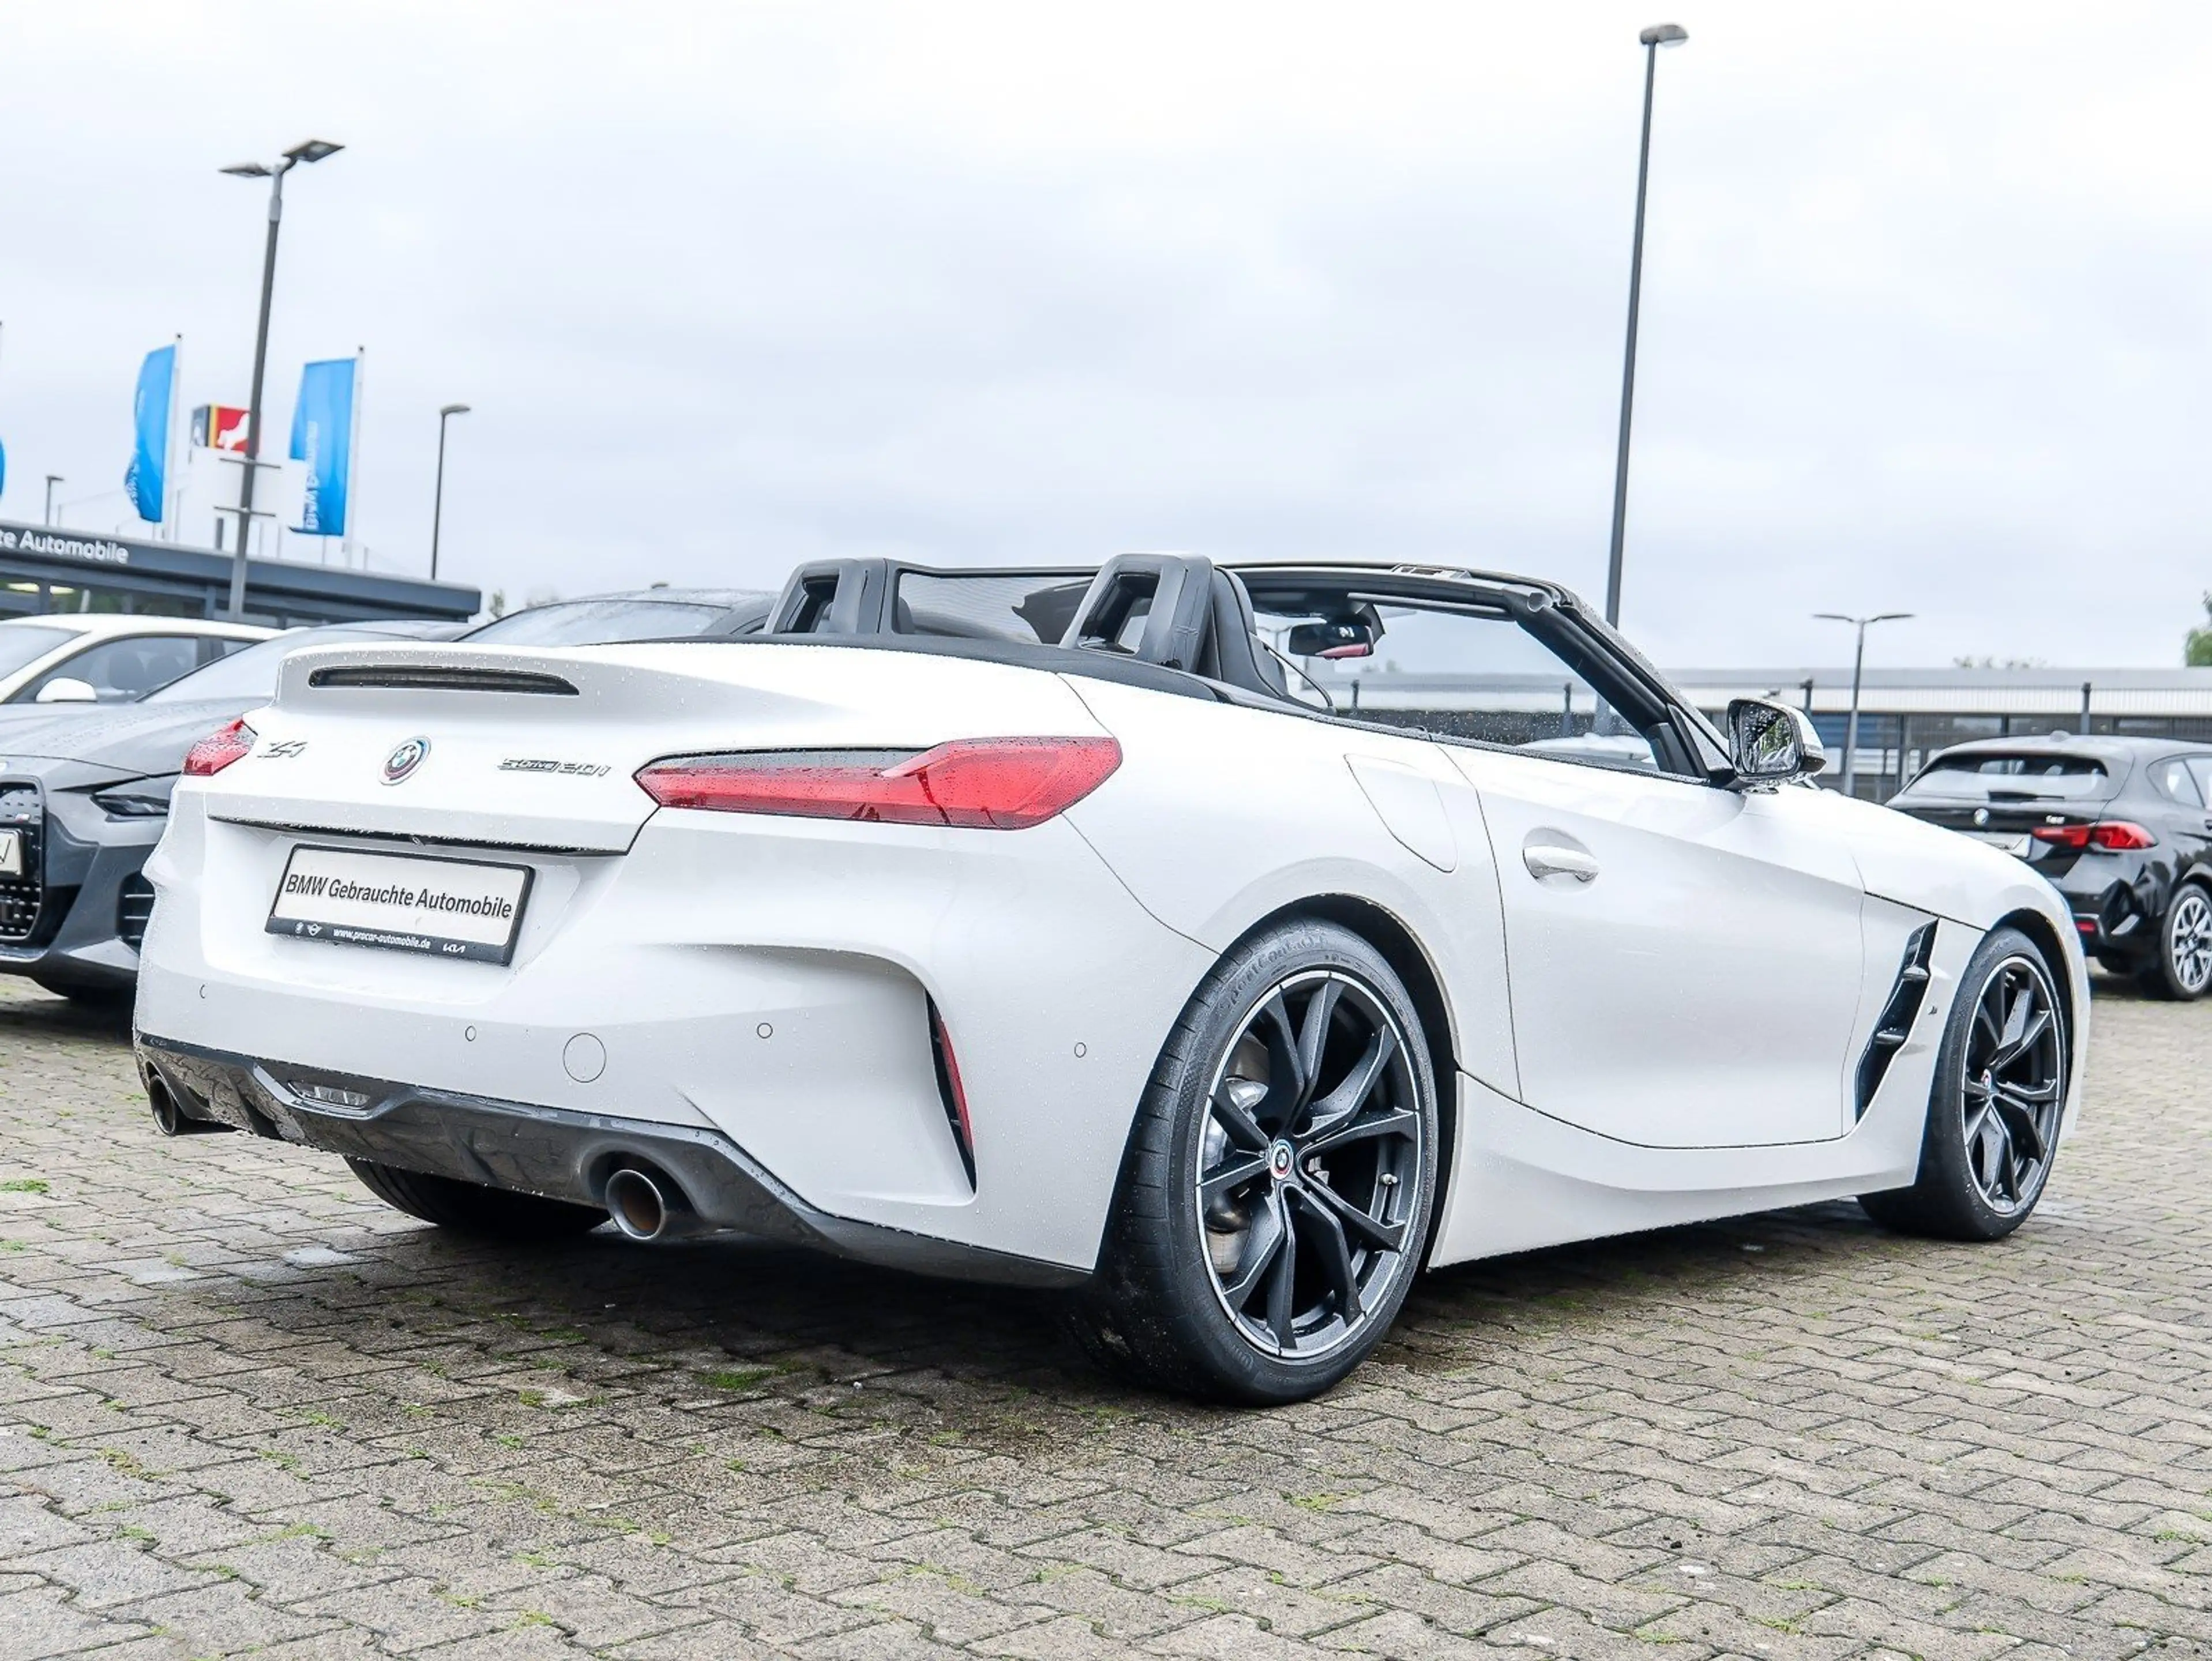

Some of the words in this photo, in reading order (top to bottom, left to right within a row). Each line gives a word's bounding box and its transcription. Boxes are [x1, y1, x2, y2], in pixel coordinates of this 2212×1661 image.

[19, 529, 129, 564] Automobile
[286, 874, 328, 896] BMW
[329, 878, 414, 907] Gebrauchte
[415, 888, 512, 918] Automobile
